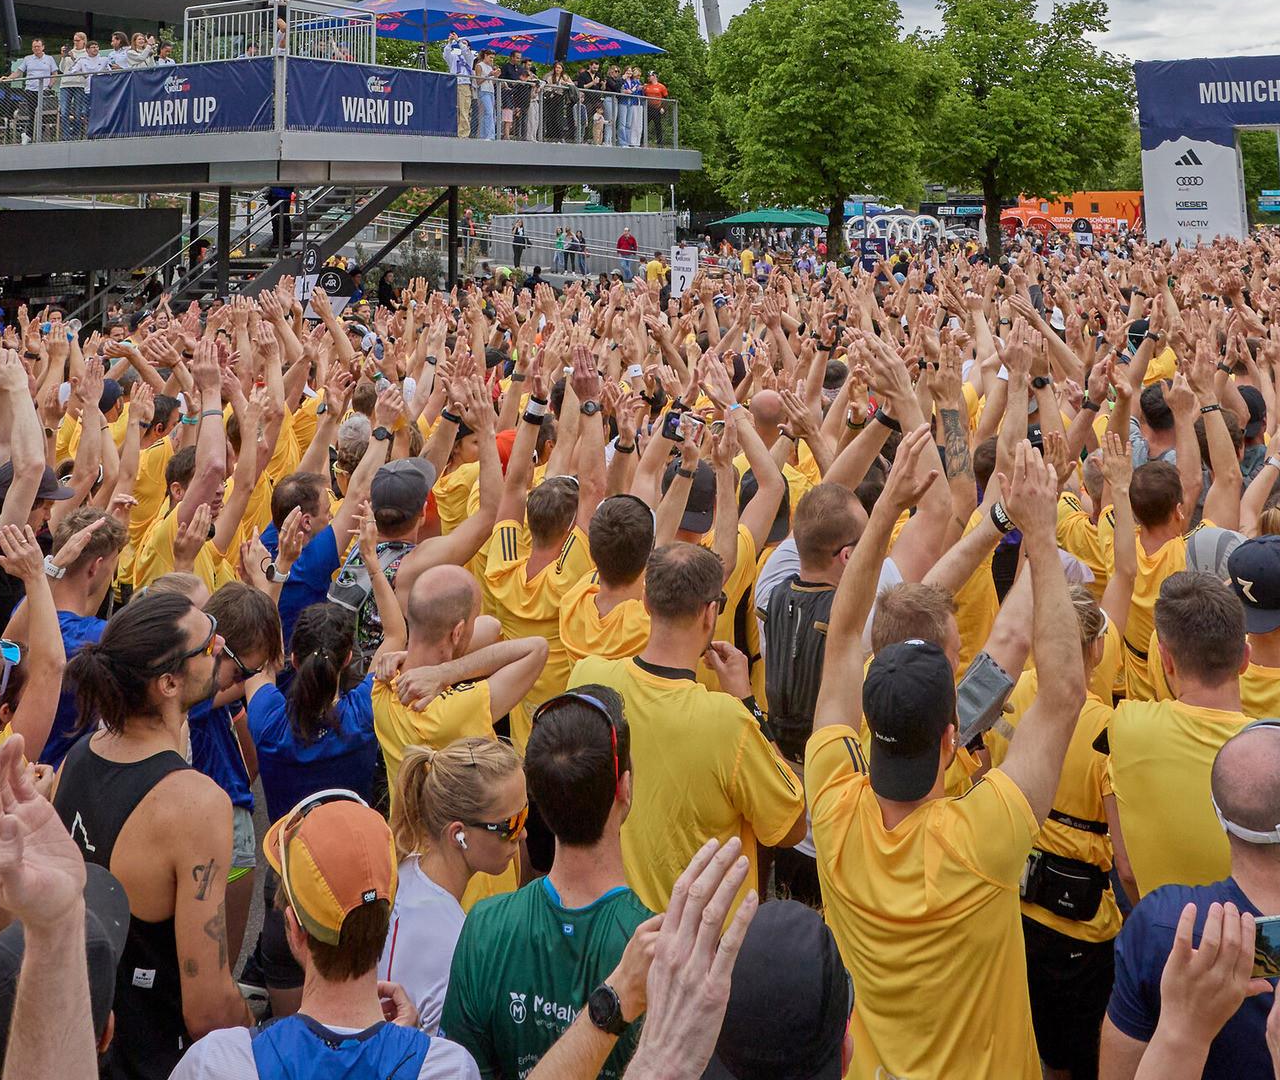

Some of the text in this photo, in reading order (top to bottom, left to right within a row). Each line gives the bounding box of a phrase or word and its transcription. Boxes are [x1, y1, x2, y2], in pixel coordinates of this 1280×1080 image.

[139, 96, 217, 127] WARM UP
[341, 96, 414, 126] WARM UP
[679, 275, 686, 293] 2
